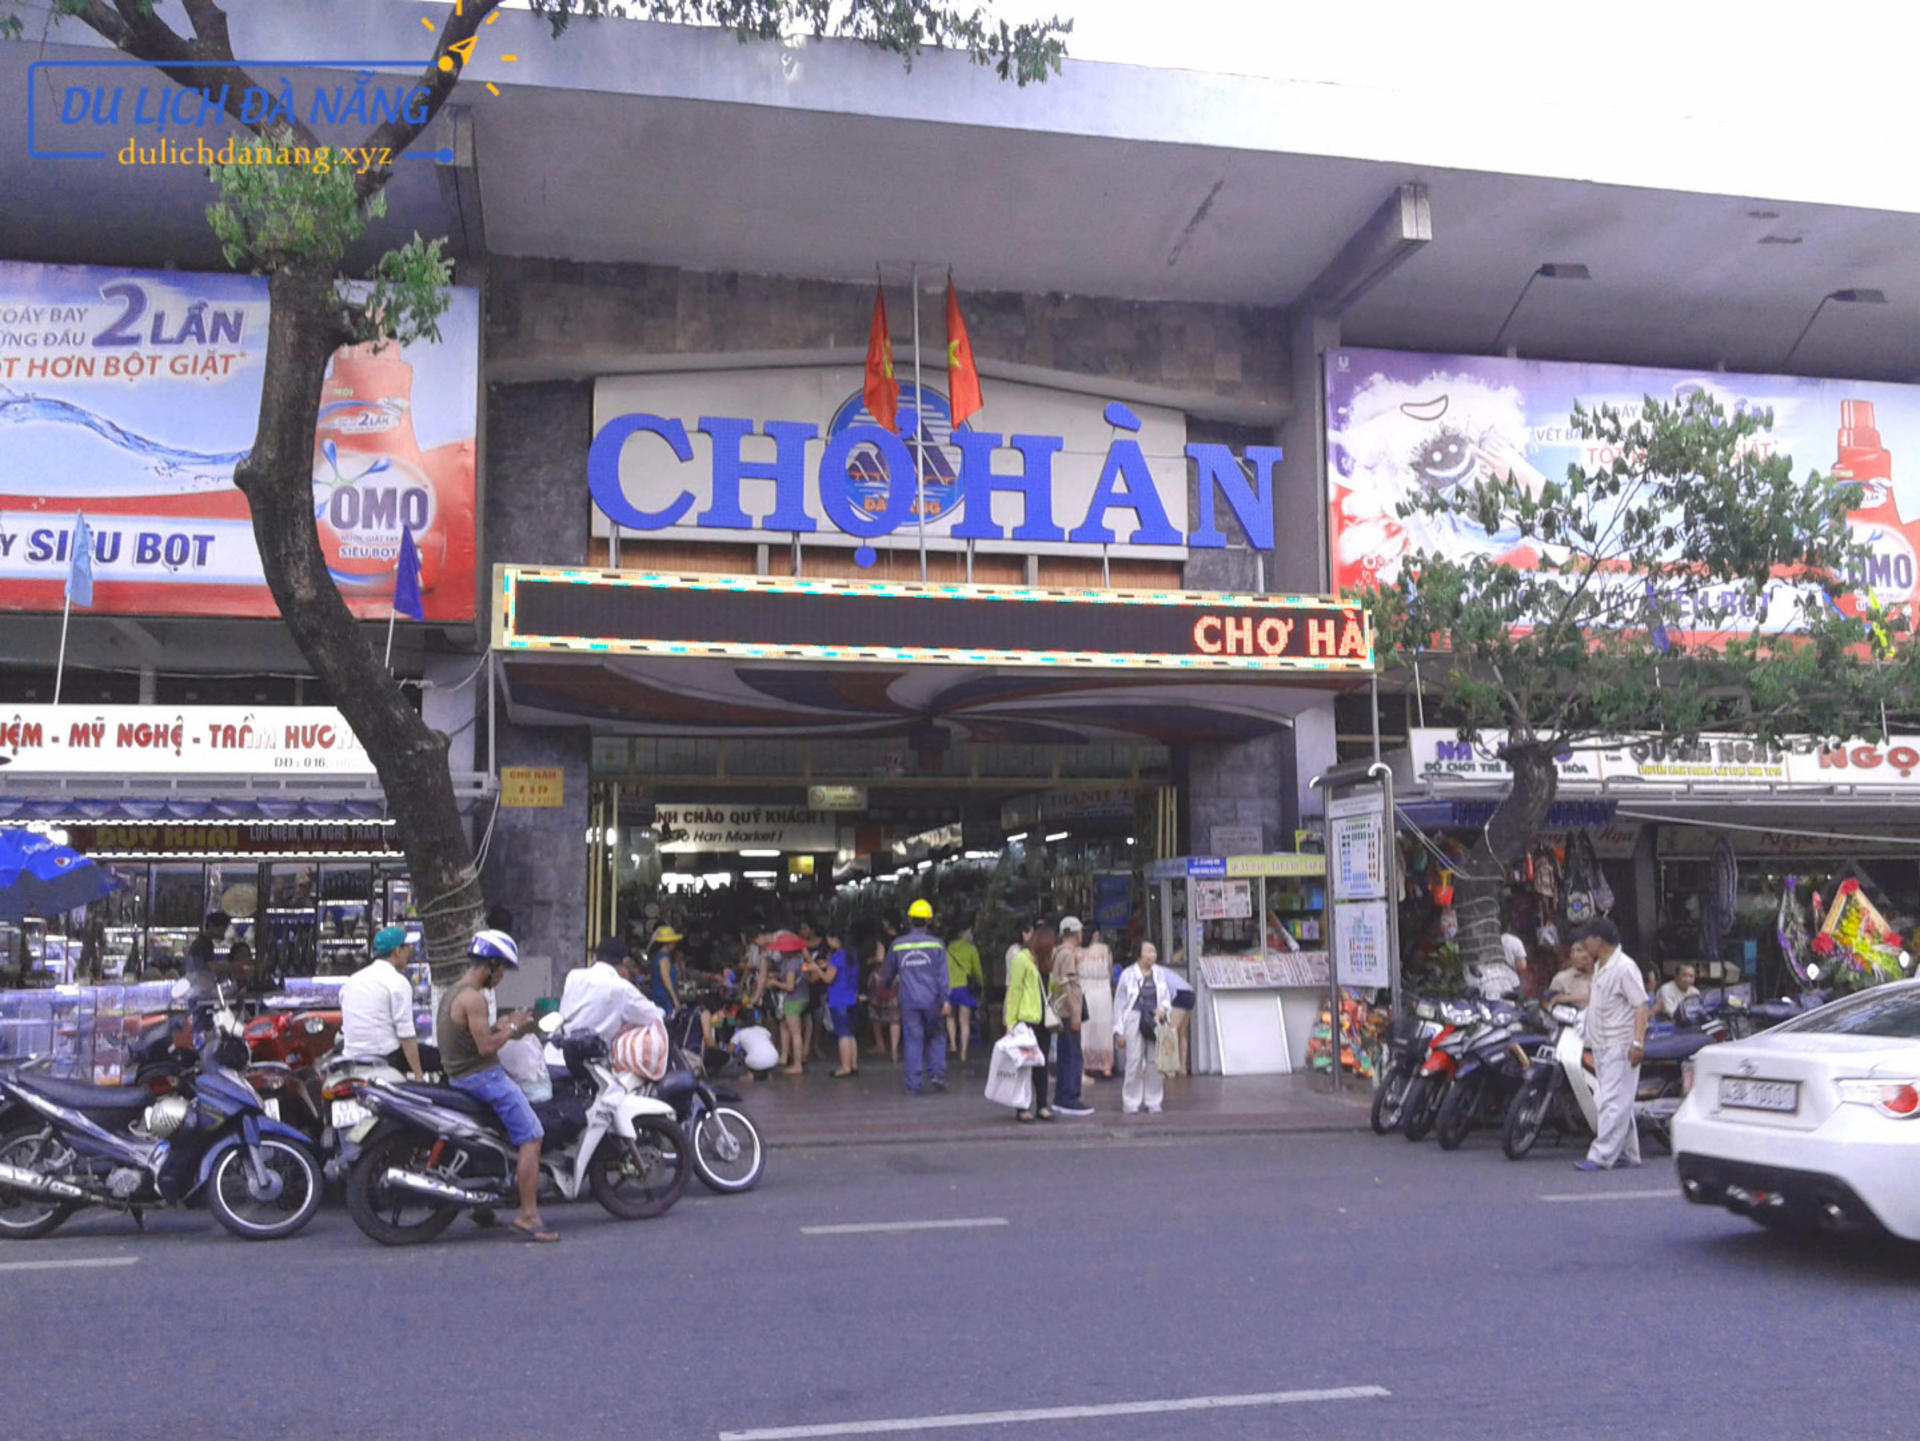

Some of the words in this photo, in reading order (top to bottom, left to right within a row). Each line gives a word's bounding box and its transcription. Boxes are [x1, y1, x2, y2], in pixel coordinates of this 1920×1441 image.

[50, 307, 88, 323] BAY
[92, 283, 148, 346] 2
[27, 354, 96, 378] HƠN
[103, 351, 163, 382] BỘT
[587, 408, 919, 568] CHỢ
[950, 402, 1282, 549] HÀN
[330, 485, 429, 531] OMO
[28, 524, 122, 564] SIU
[69, 716, 106, 748] MỸ
[117, 715, 184, 757] NGHỆ
[683, 807, 724, 824] CHÀO
[693, 831, 722, 842] Han
